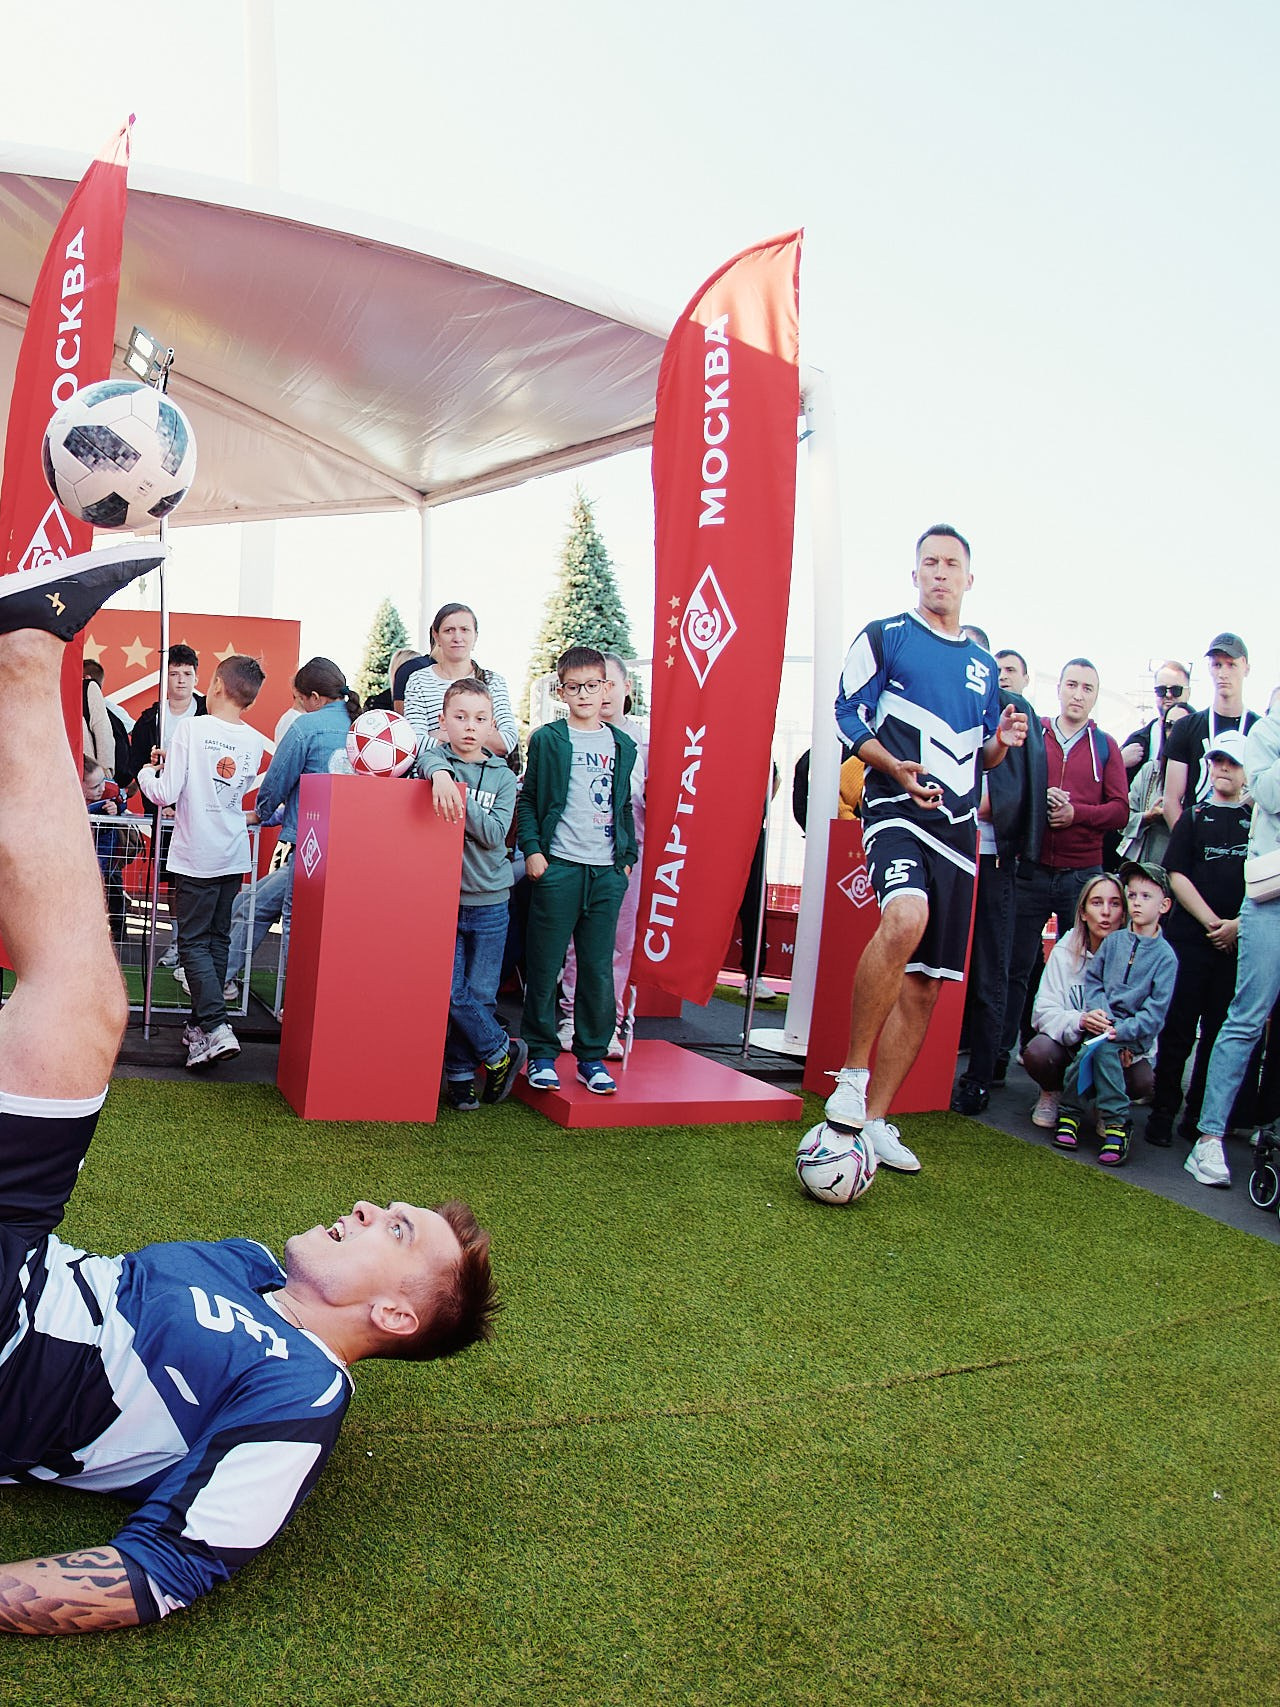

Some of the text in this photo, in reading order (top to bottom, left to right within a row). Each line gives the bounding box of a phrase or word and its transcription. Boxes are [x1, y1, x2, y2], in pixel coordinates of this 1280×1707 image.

[51, 225, 86, 410] ОСКВА
[698, 313, 730, 529] МОСКВА
[643, 724, 707, 963] СПАРТАК
